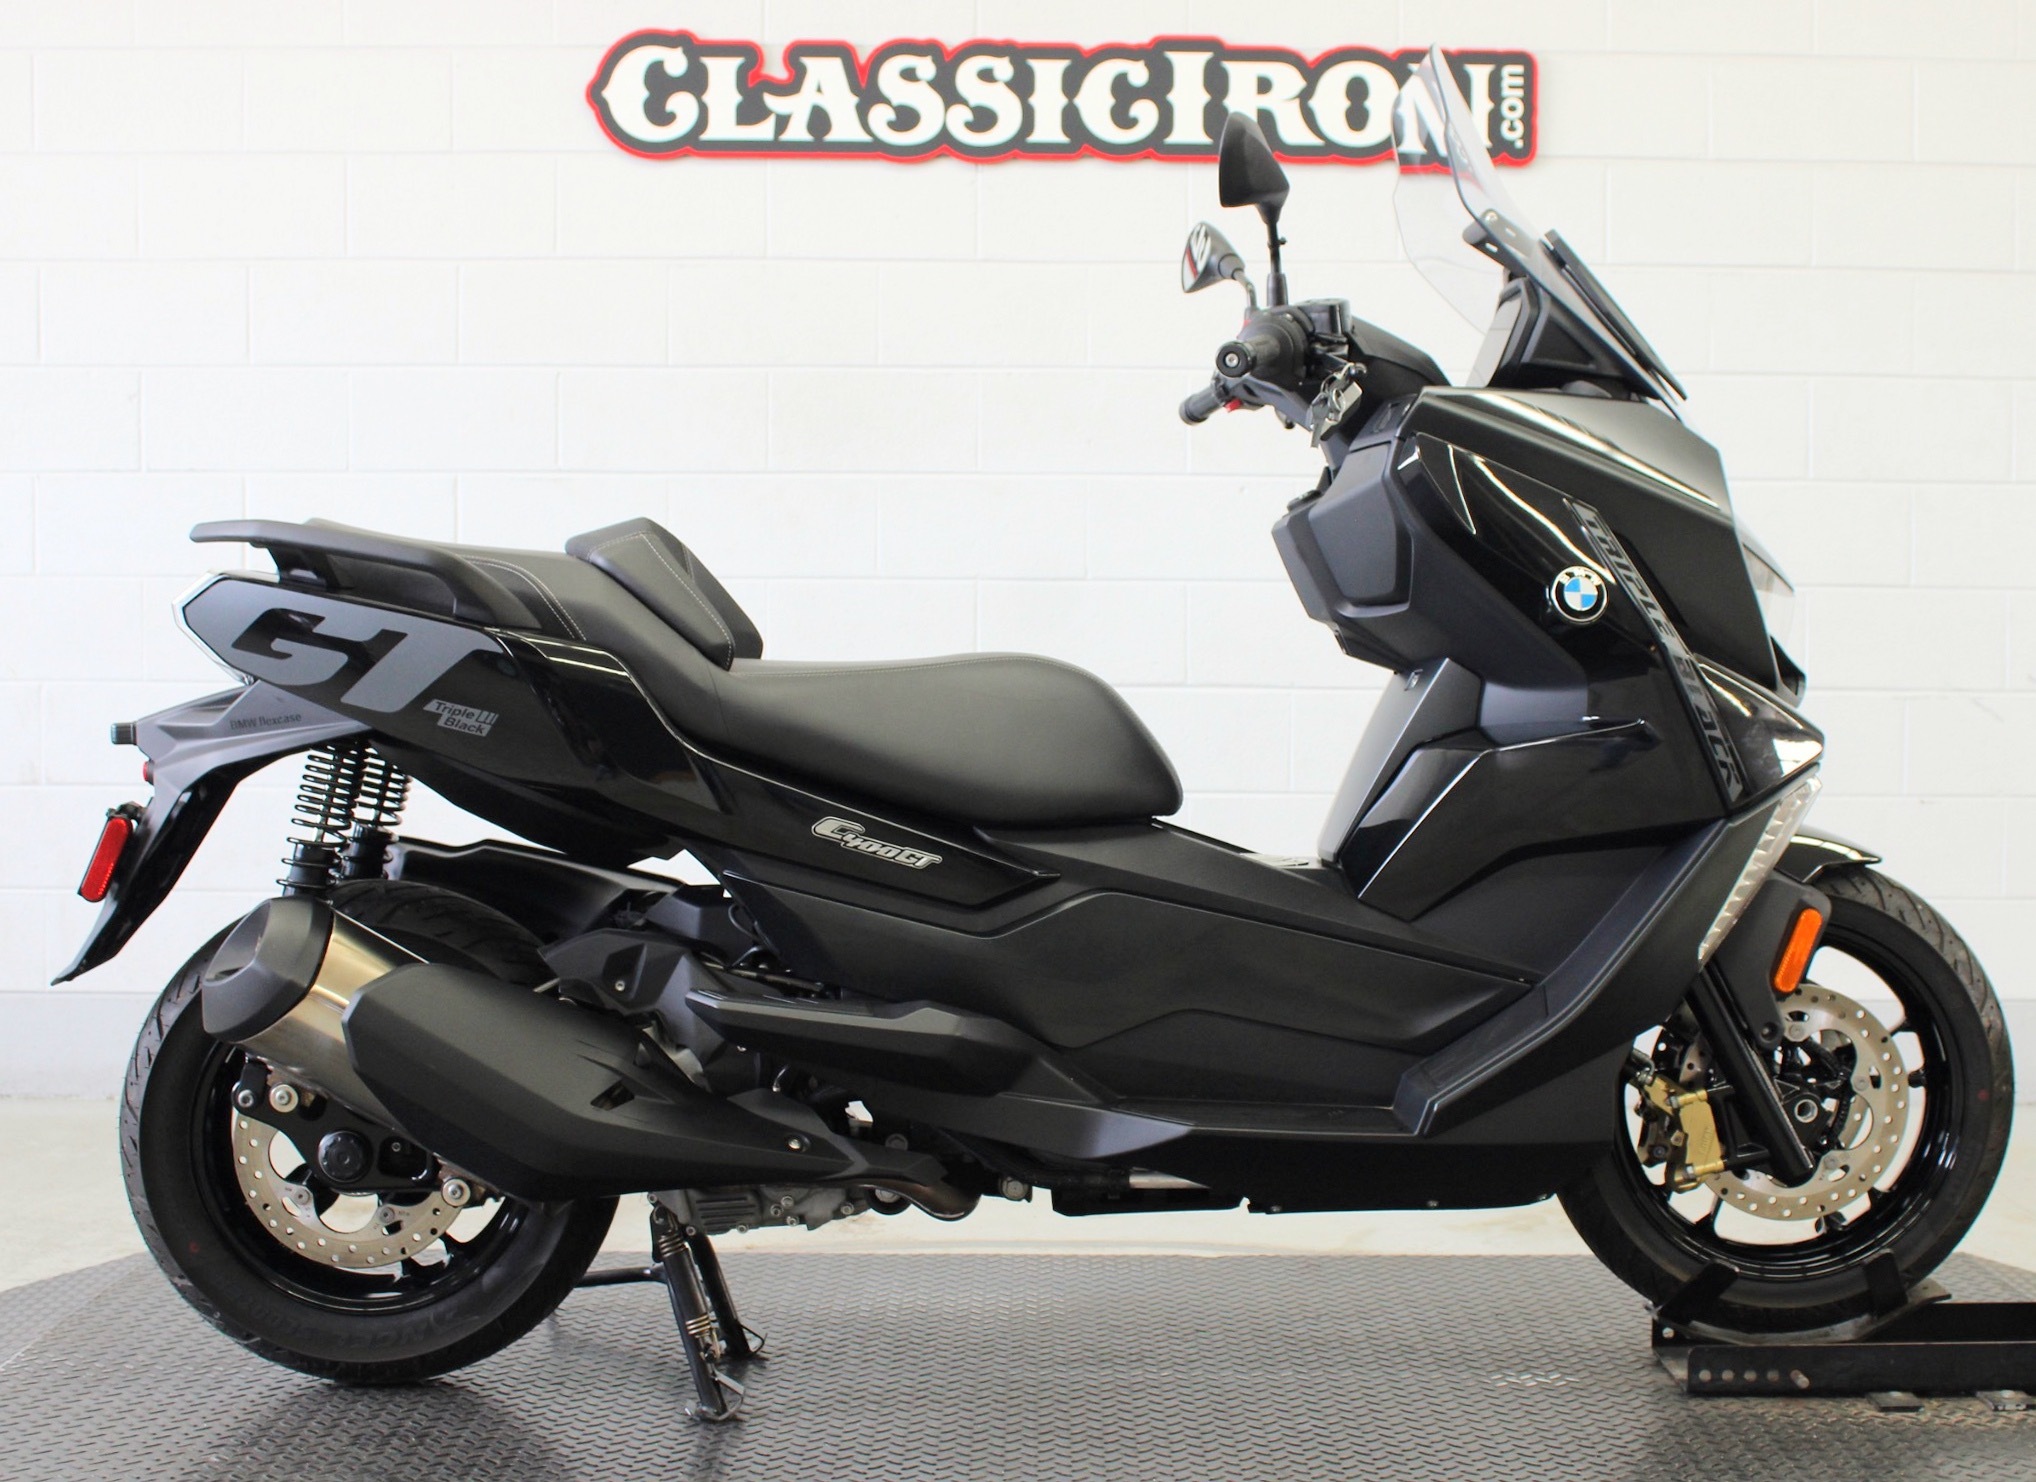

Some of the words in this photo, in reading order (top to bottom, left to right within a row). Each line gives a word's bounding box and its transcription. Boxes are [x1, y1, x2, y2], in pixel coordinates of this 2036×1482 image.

[1501, 65, 1524, 148] .com
[1585, 516, 1674, 636] TRIPLE
[183, 579, 503, 713] GT
[435, 701, 475, 719] Triple
[444, 716, 486, 734] Black
